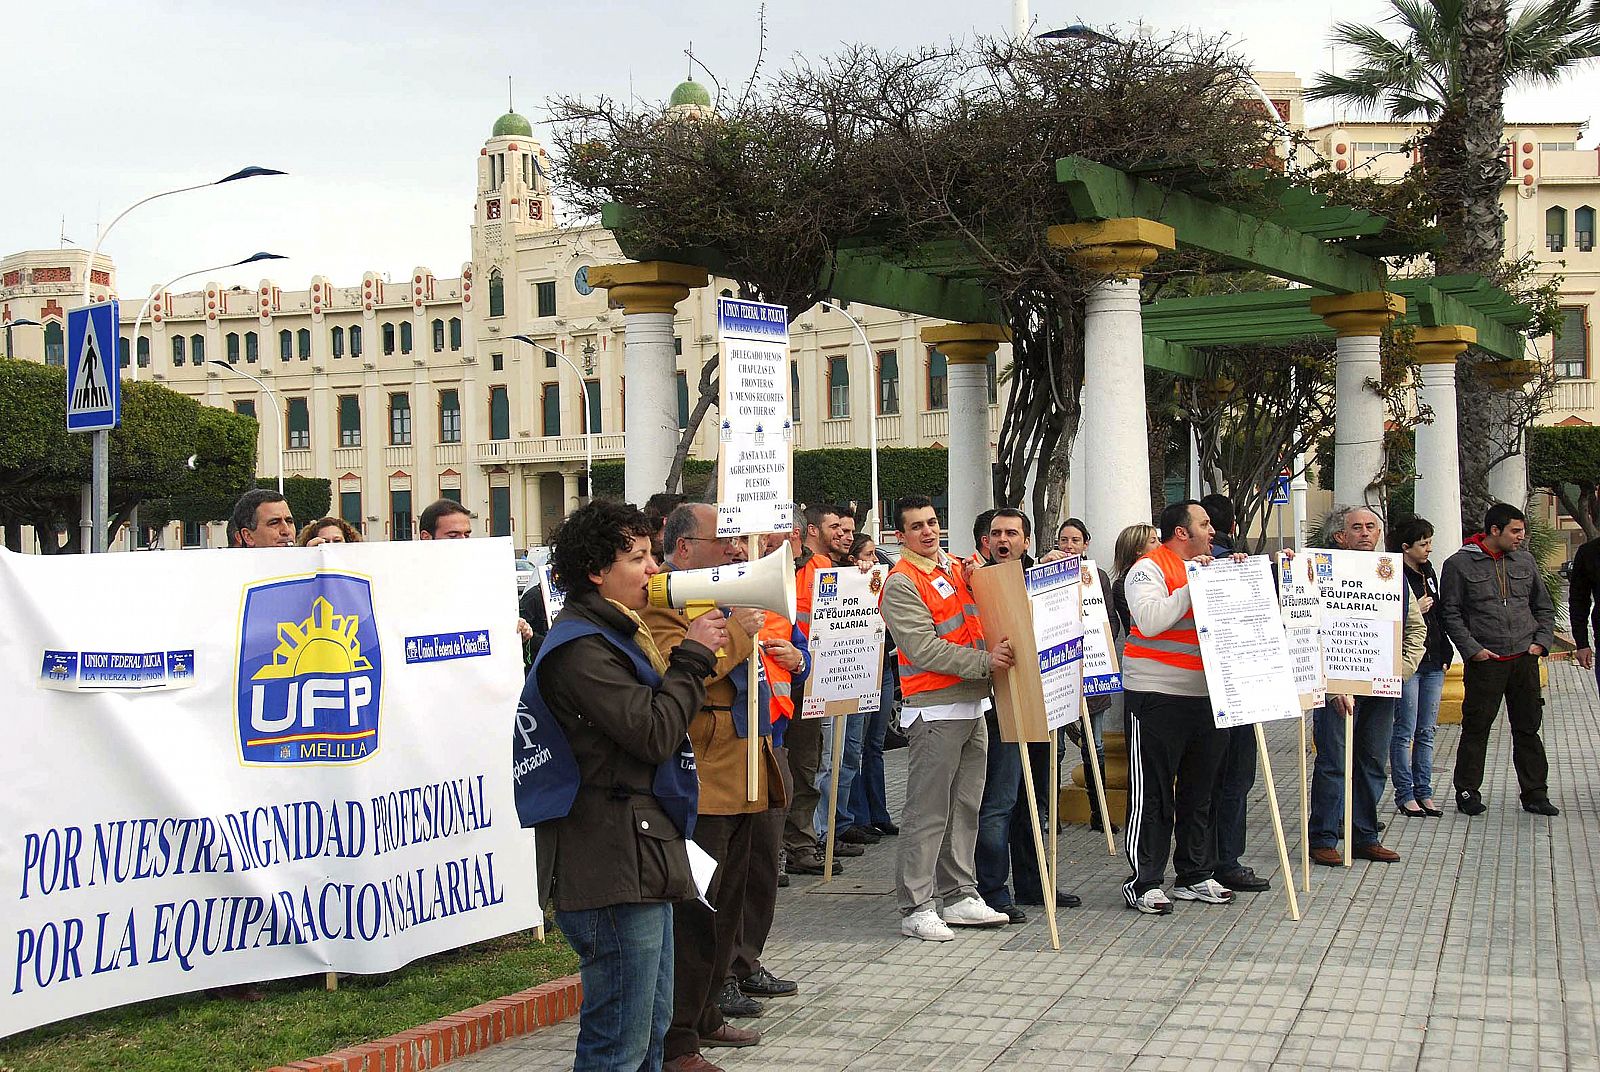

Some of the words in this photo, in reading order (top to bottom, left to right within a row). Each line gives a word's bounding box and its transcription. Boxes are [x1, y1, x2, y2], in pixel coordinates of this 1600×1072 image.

[740, 304, 760, 320] FEDERAL
[760, 308, 766, 320] DE
[734, 323, 752, 333] FUERZA
[763, 351, 782, 362] MENOS
[738, 364, 768, 374] CHAPUZAS
[768, 366, 776, 374] EN
[742, 378, 774, 388] FRONTERAS
[730, 392, 734, 400] Y
[736, 392, 756, 401] MENOS
[756, 393, 784, 402] RECORTES
[740, 406, 752, 416] CON
[739, 450, 758, 462] ¡BASTA
[769, 450, 776, 459] DE
[730, 465, 766, 475] AGRESIONES
[766, 464, 774, 473] EN
[774, 463, 784, 472] LOS
[746, 478, 770, 488] PUESTOS
[736, 490, 778, 502] FRONTERIZOS!
[820, 583, 838, 593] UFP
[1342, 580, 1363, 588] POR
[1296, 586, 1304, 594] POR
[1320, 590, 1400, 602] EQUIPARACIÓN
[842, 598, 859, 606] POR
[1326, 602, 1378, 612] SALARIAL
[1290, 610, 1312, 618] SALARIAL
[830, 620, 868, 630] SALARIAL
[1332, 622, 1350, 630] ¡LOS
[1353, 620, 1368, 629] MÁS
[1322, 630, 1378, 638] SACRIFICADOS
[434, 637, 454, 656] Federal
[454, 640, 460, 655] de
[833, 638, 864, 648] ZAPATERO
[1344, 638, 1369, 646] ESTÁN
[820, 648, 853, 658] SUSPENDES
[84, 654, 108, 668] UNION
[110, 655, 142, 668] FEDERAL
[1082, 660, 1106, 668] CILLOS
[828, 664, 864, 674] RUBALCABA
[1328, 664, 1370, 672] FRONTERA
[50, 672, 70, 681] UFP
[100, 674, 127, 682] FUERZA
[173, 670, 188, 680] UFP
[1088, 682, 1094, 692] de
[250, 674, 372, 733] UFP
[300, 740, 368, 760] MELILLA
[20, 826, 83, 900] POR
[88, 816, 234, 886] NUESTRA
[225, 799, 366, 871] DIGNIDAD
[371, 775, 492, 856] PROFESIONAL
[12, 918, 83, 995] POR
[92, 906, 139, 974] LA
[148, 878, 398, 972] EQUIPARACION
[395, 852, 504, 932] SALARIAL
